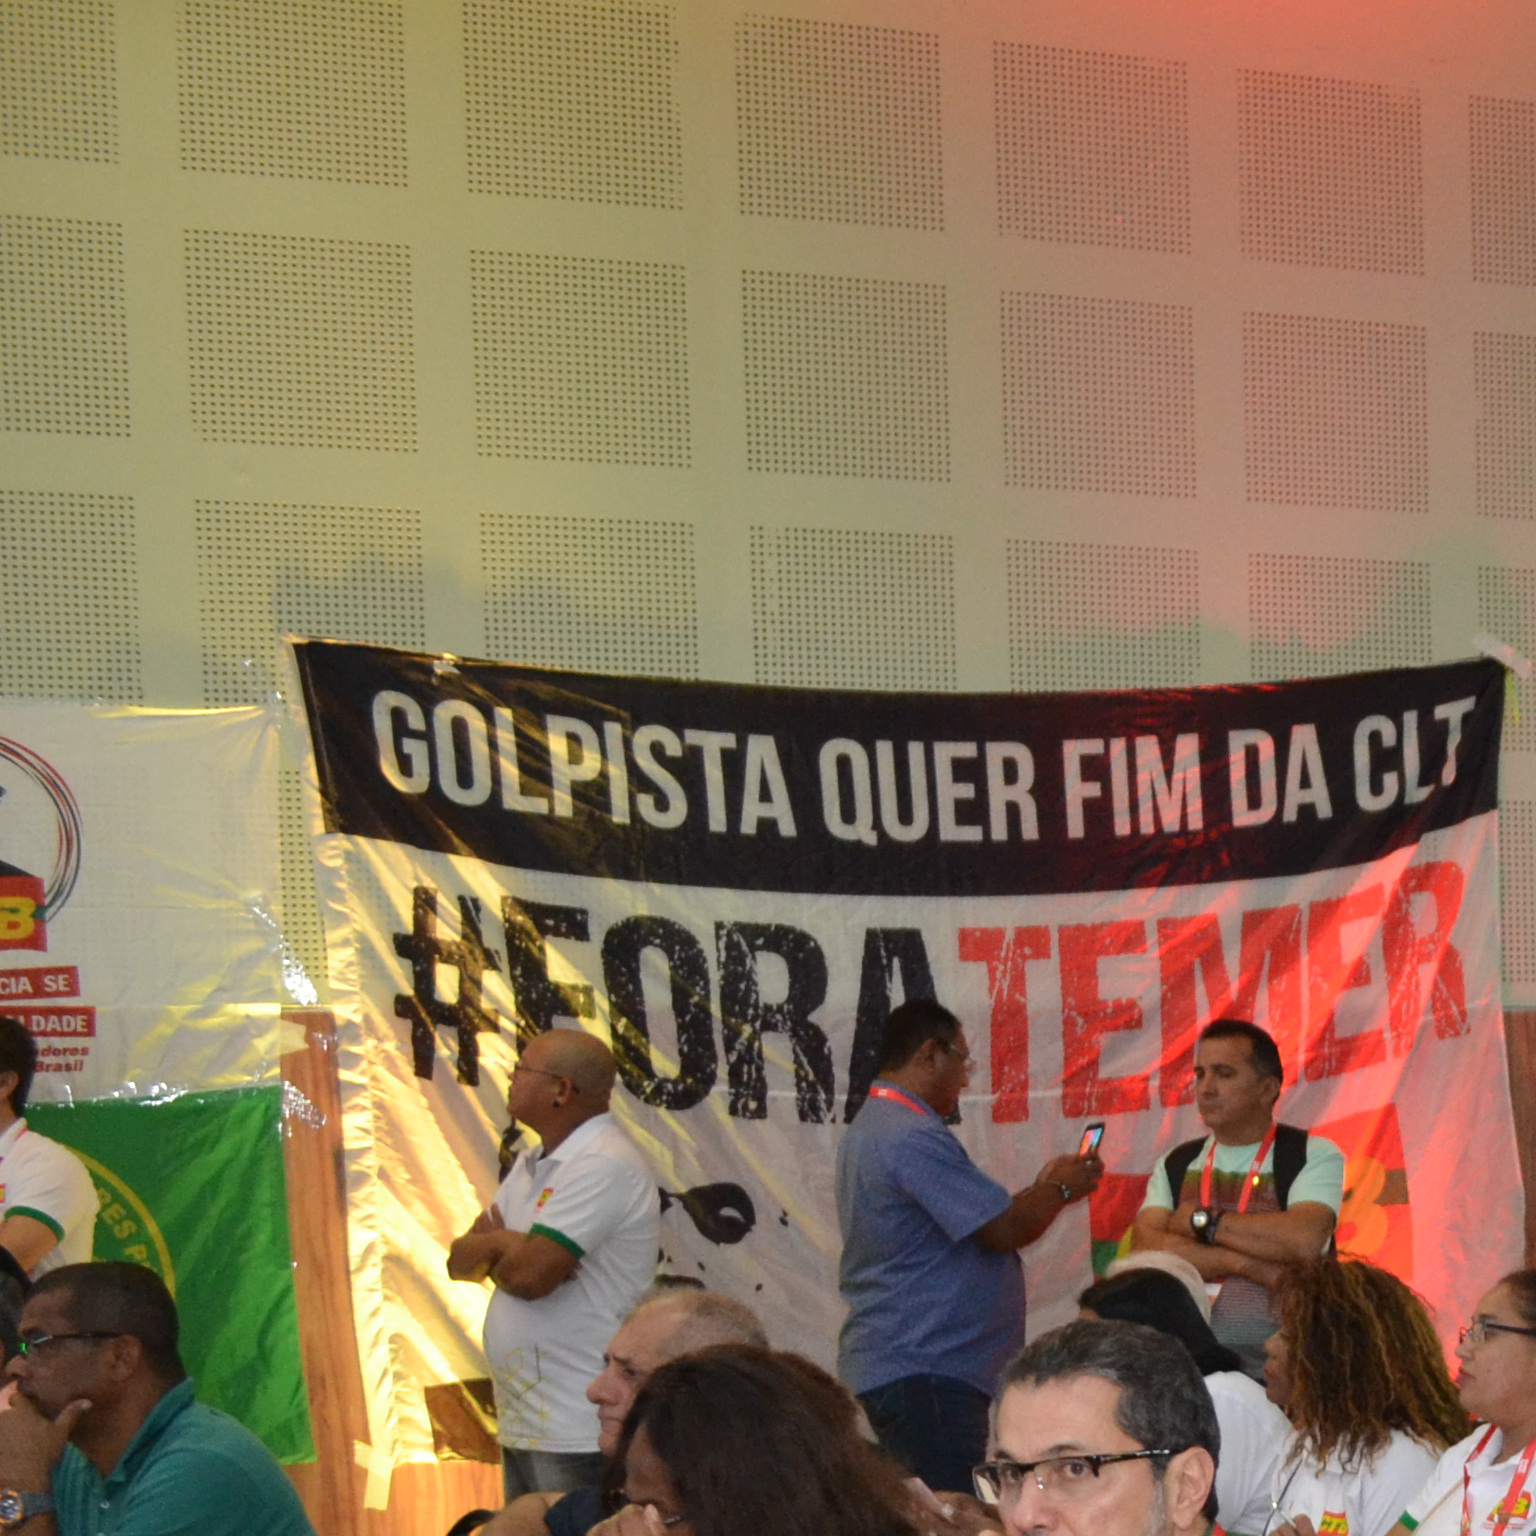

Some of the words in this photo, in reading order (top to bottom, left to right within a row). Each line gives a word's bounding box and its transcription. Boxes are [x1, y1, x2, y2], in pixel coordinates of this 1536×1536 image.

[372, 689, 799, 839] GOLPISTA
[818, 736, 1040, 846] QUER
[1063, 729, 1204, 840] FIM
[1228, 723, 1332, 829] DA
[1352, 696, 1476, 812] CLT
[43, 974, 71, 993] SE
